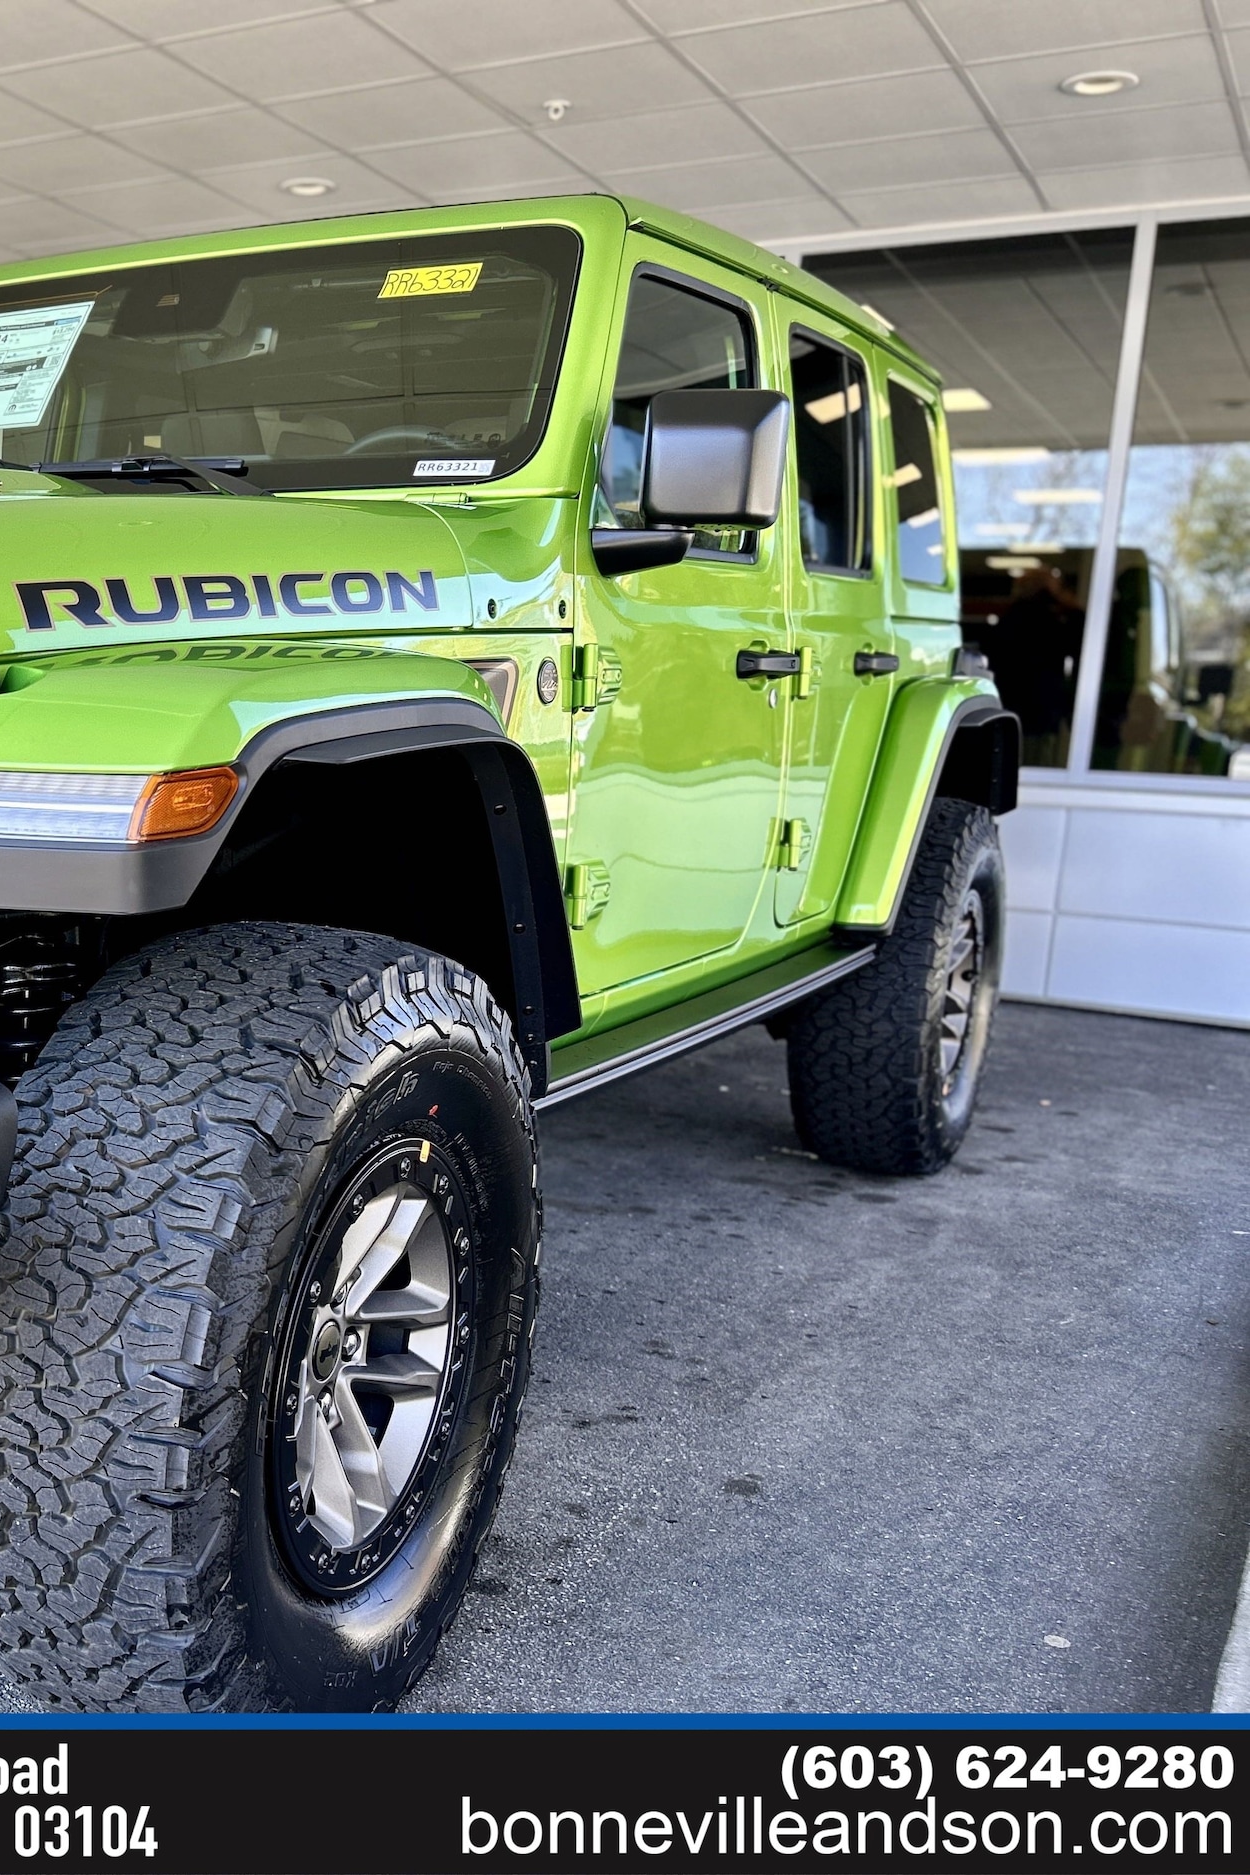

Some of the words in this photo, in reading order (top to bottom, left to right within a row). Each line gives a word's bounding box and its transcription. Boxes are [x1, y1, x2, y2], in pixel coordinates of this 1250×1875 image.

[380, 267, 479, 296] RR63321
[417, 462, 478, 472] RR63321
[12, 570, 440, 632] RUBICON
